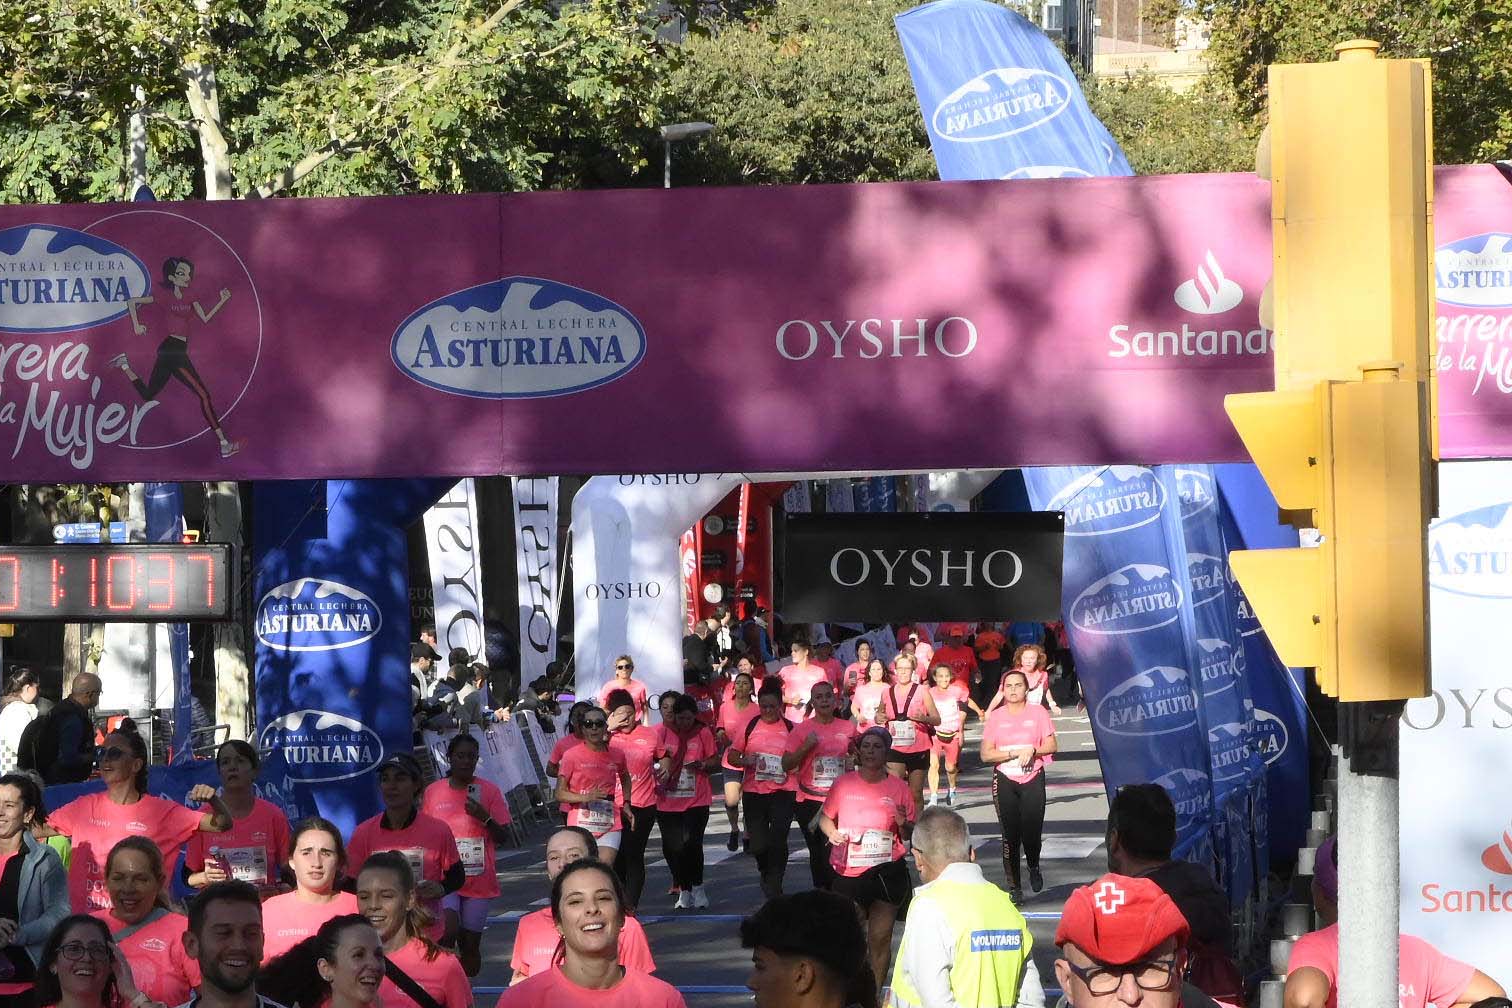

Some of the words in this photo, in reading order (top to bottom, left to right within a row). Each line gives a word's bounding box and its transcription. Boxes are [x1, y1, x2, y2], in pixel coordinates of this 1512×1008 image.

[54, 260, 125, 271] LECHERA
[450, 320, 528, 333] CENTRAL
[537, 317, 617, 330] LECHERA
[775, 316, 977, 360] OYSHO
[1436, 313, 1512, 343] arrer
[411, 324, 626, 369] ASTURIANA
[1108, 323, 1275, 357] Santand
[1459, 343, 1477, 371] la
[12, 376, 160, 470] Mujer
[830, 547, 1023, 588] OYSHO
[585, 581, 661, 600] OYSHO
[273, 603, 314, 611] CENTRAL
[320, 602, 368, 611] LECHERA
[260, 608, 373, 635] ASTURIANA
[1402, 688, 1512, 730] OYS
[284, 745, 374, 764] TURIANA
[231, 865, 251, 874] 016
